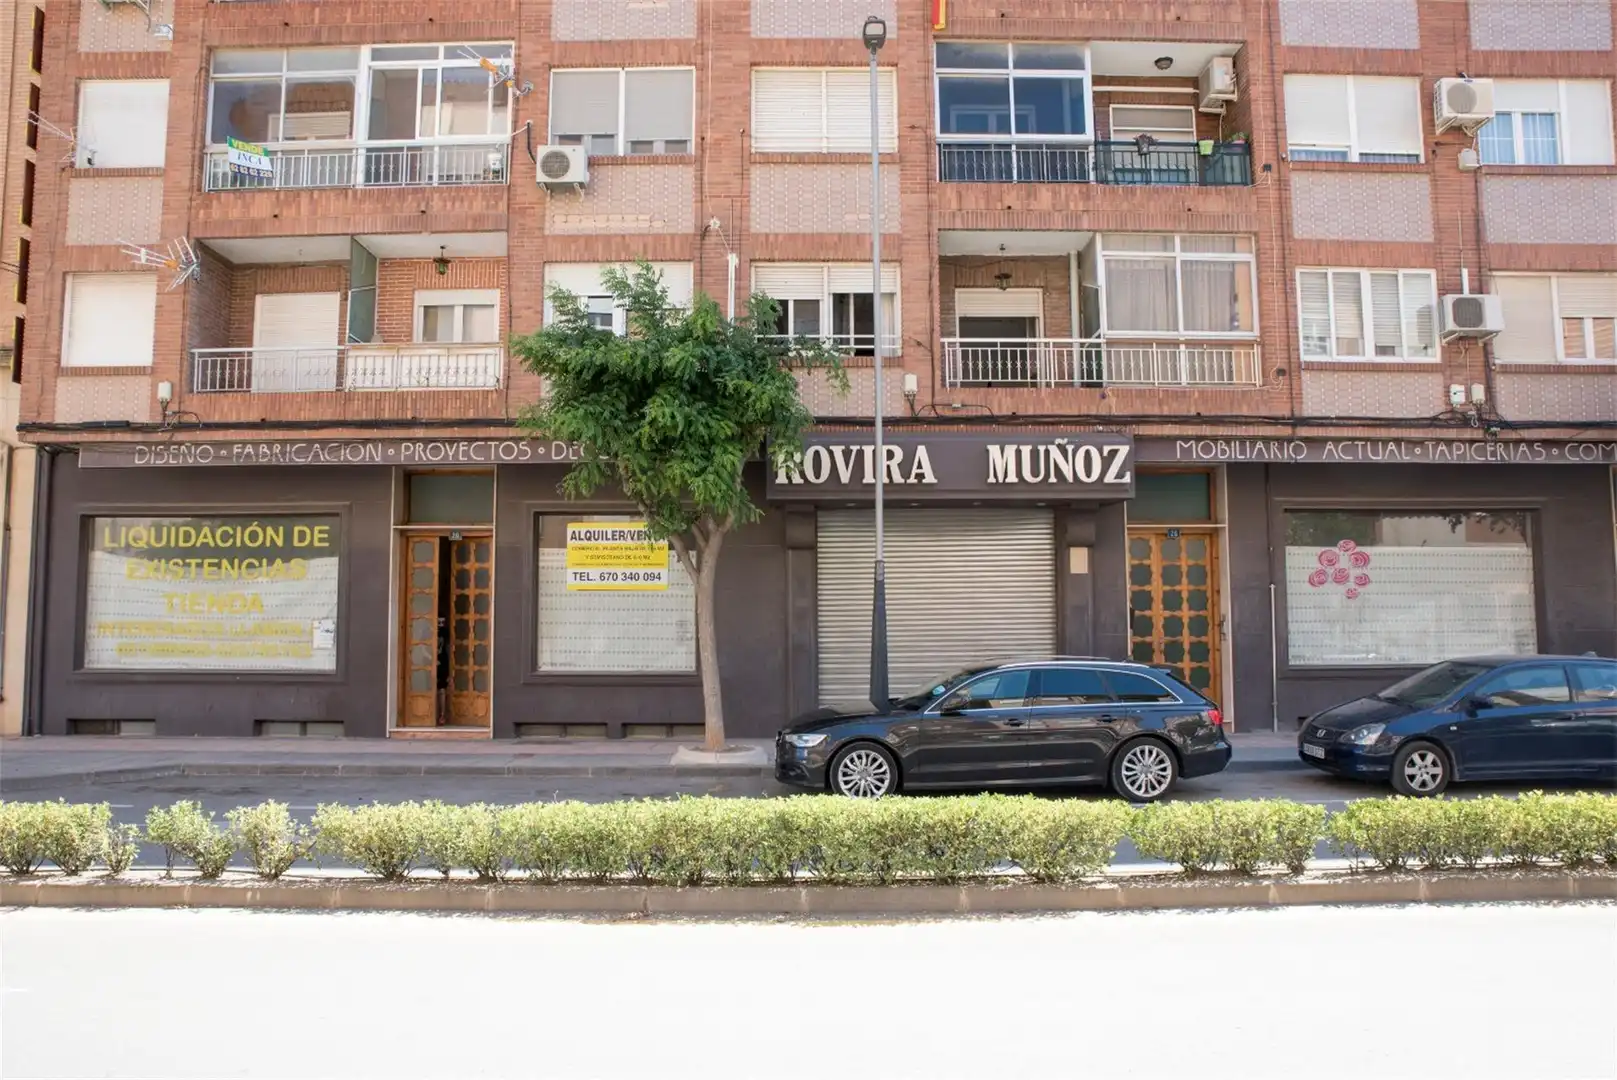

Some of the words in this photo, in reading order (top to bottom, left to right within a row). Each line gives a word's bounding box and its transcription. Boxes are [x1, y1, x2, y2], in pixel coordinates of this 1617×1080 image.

[232, 139, 264, 155] VENDE
[237, 151, 262, 165] INCA
[401, 441, 532, 461] PROYECTOS
[1176, 440, 1307, 459] MOBILIARIO
[1322, 441, 1410, 460] ACTUAL
[775, 444, 938, 484] ROVIRA
[986, 438, 1131, 484] MUÑOZ
[103, 521, 285, 549] LIQUIDACIÓN
[293, 525, 331, 548] DE
[125, 557, 308, 581] EXISTENCIAS
[572, 572, 596, 581] TEL.
[599, 572, 618, 581] 670
[621, 572, 640, 581] 340
[643, 572, 662, 581] 094
[161, 591, 265, 615] TIENDA
